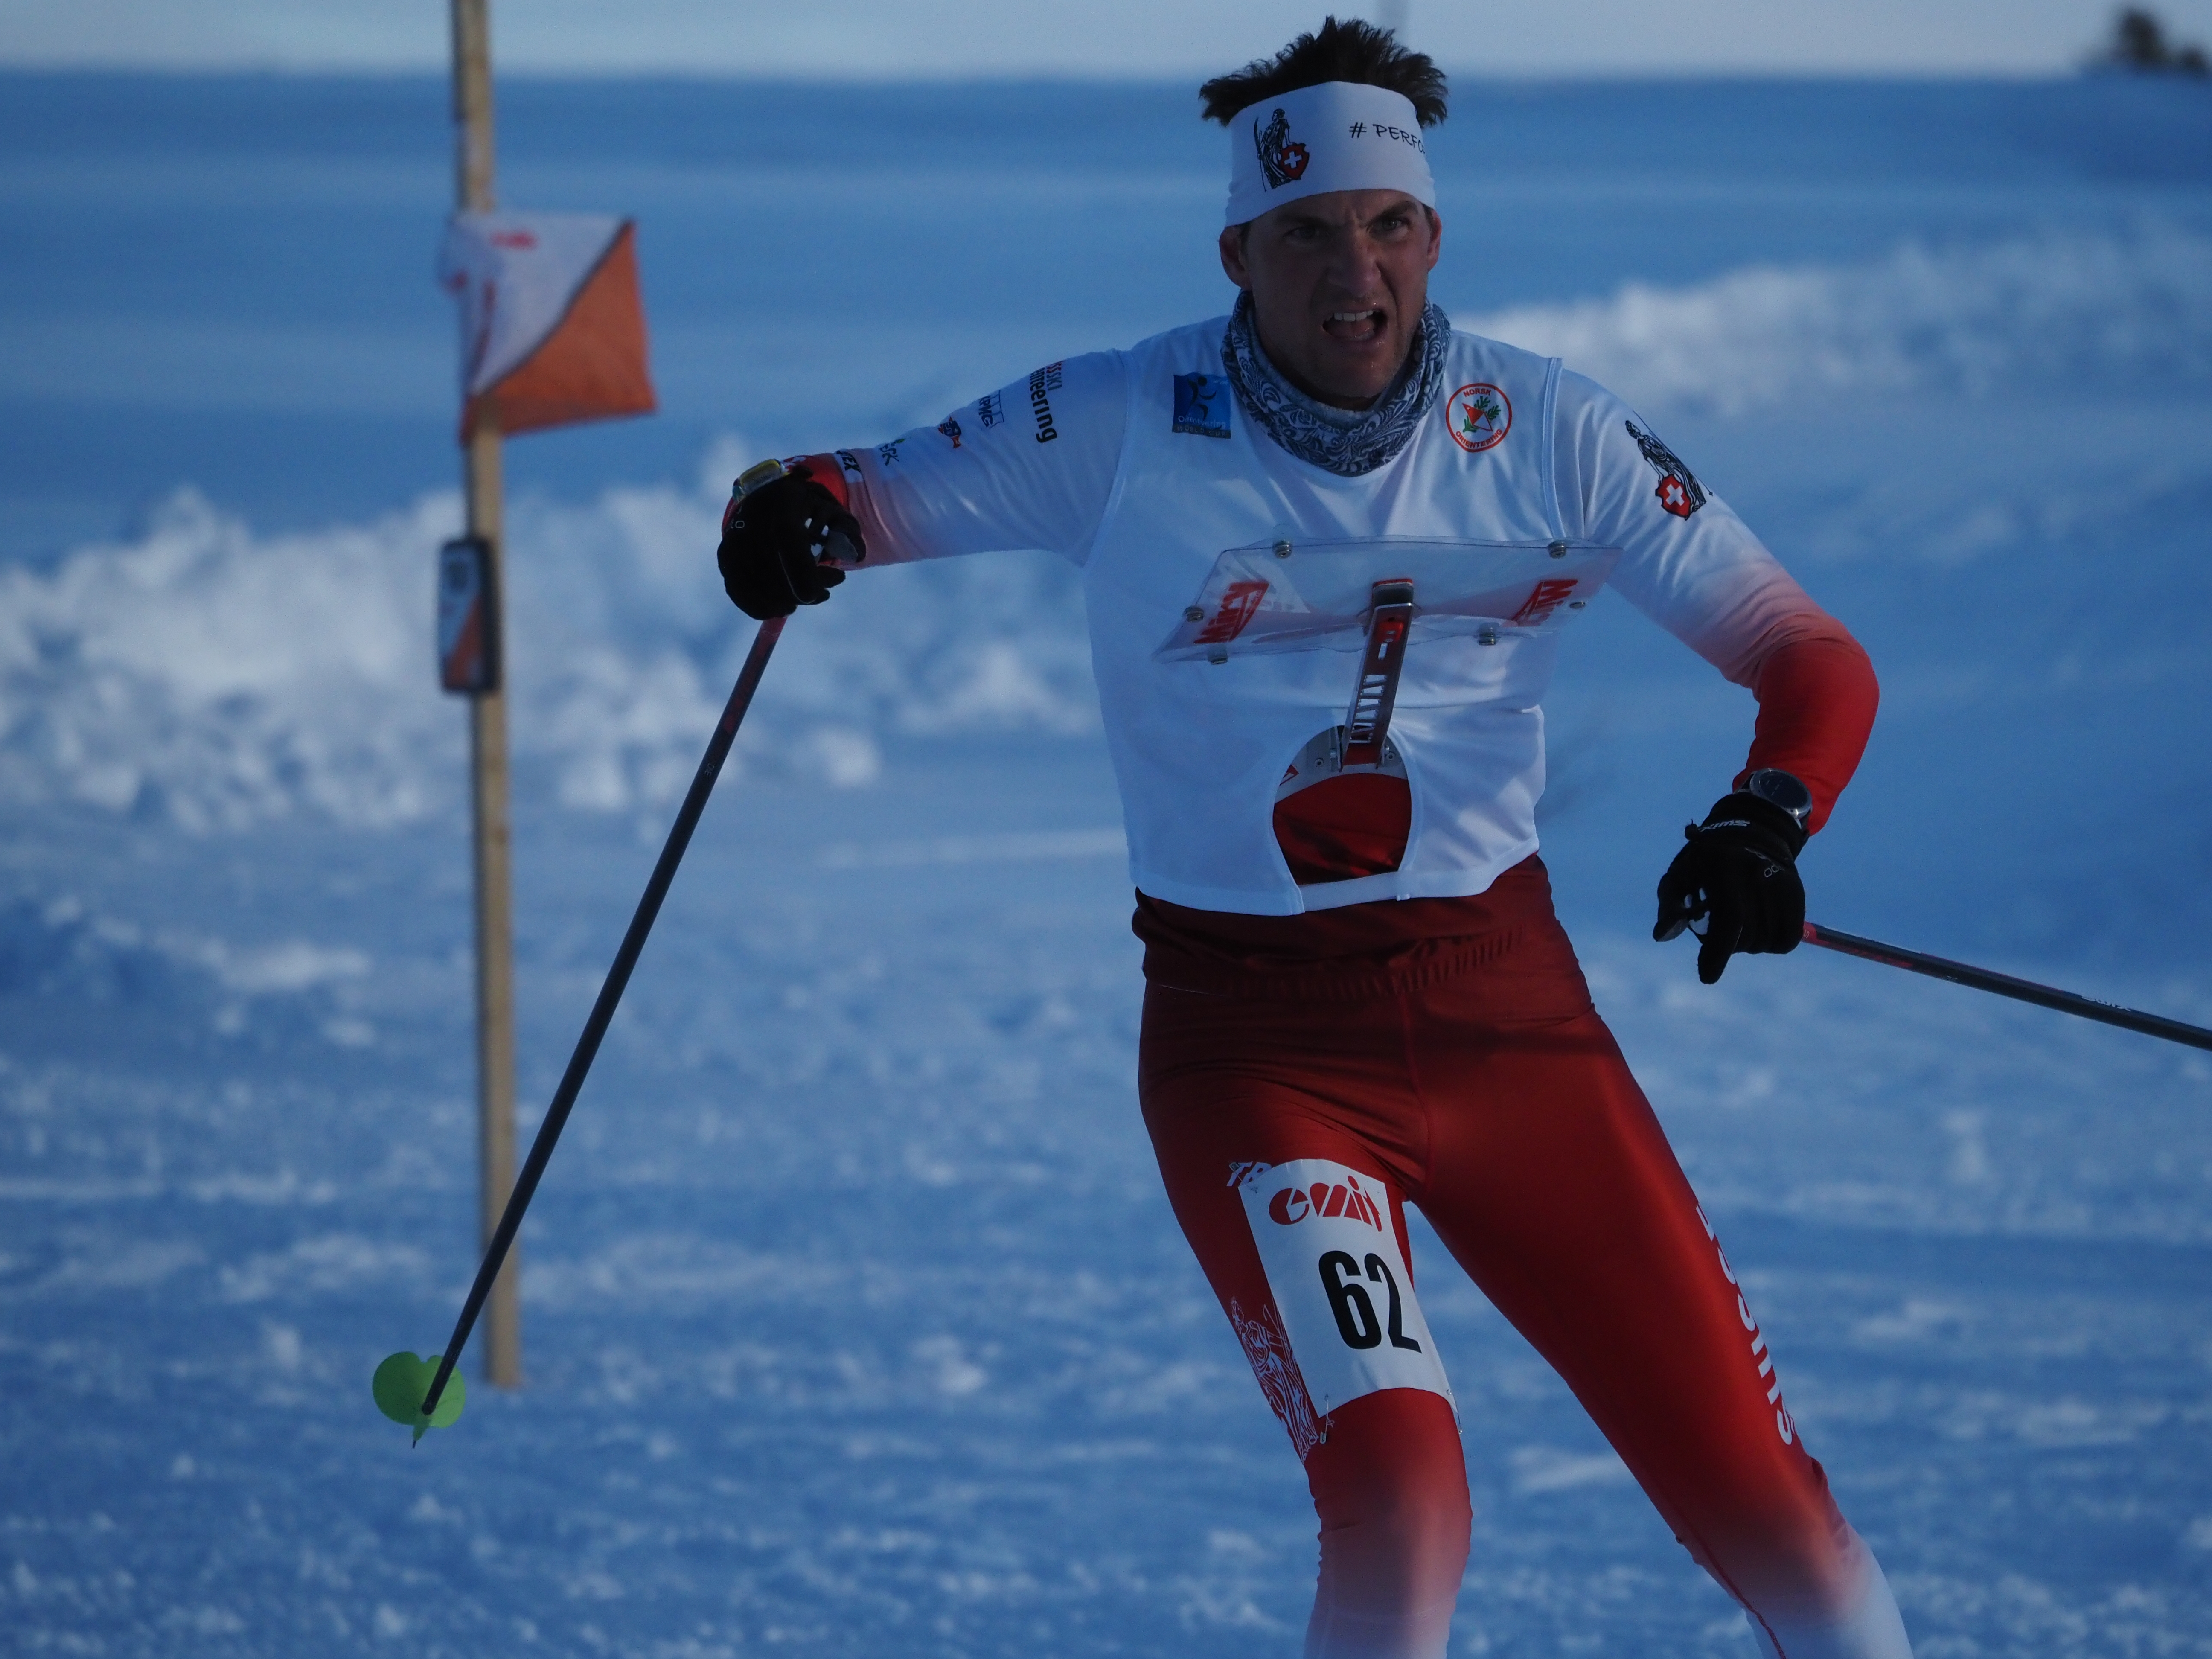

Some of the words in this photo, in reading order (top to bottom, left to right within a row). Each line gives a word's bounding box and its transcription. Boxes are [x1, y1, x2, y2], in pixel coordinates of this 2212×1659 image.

[1463, 388, 1492, 397] NORSK
[1456, 428, 1503, 448] ORIENTERING
[1318, 1250, 1423, 1354] 62
